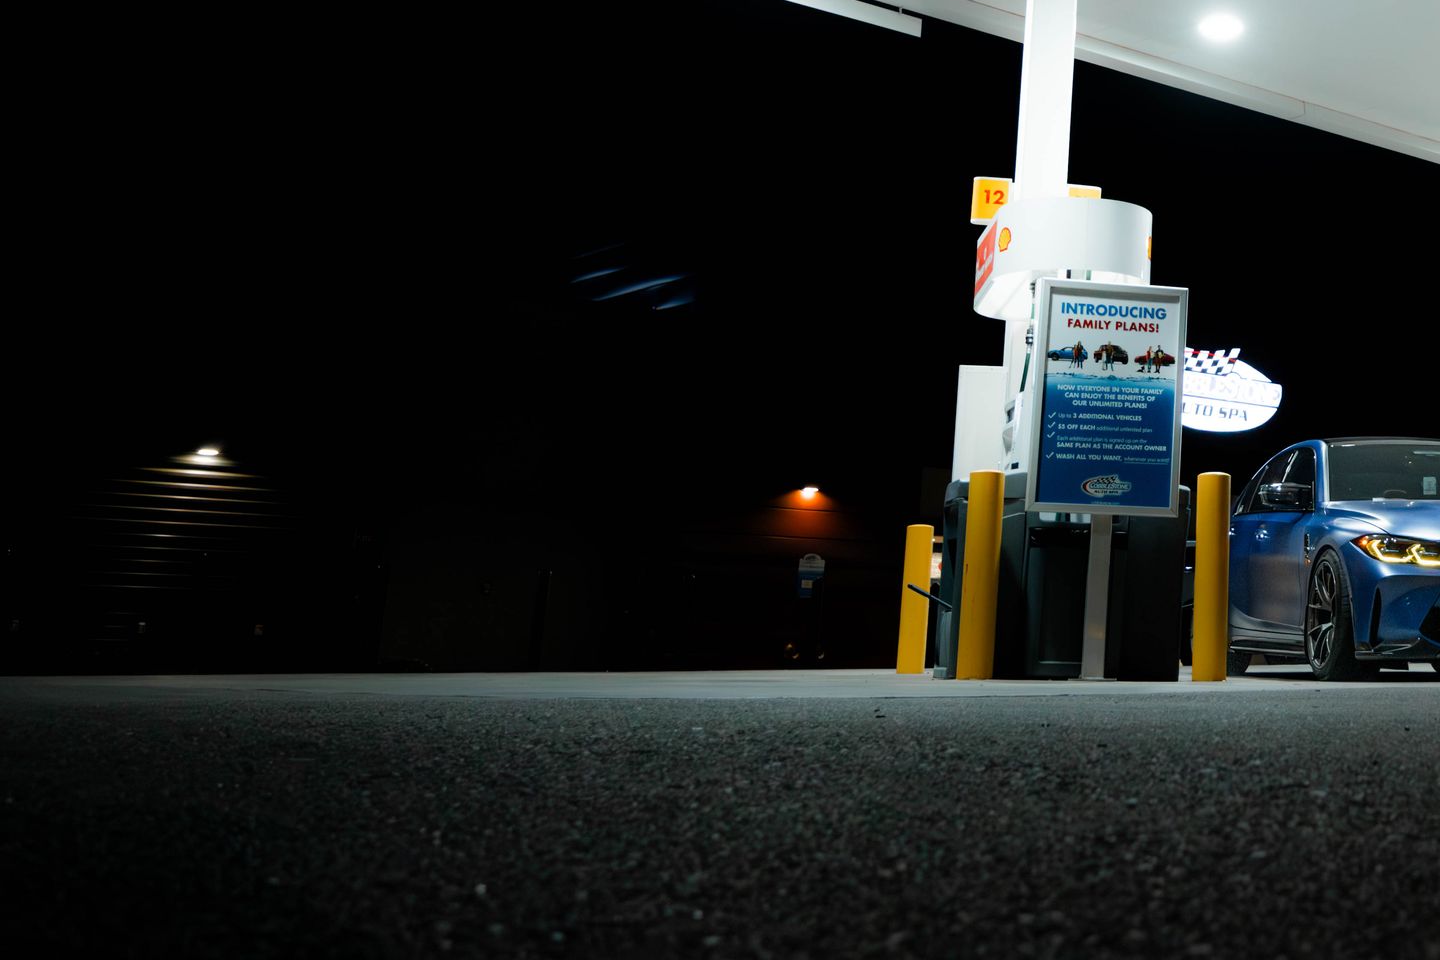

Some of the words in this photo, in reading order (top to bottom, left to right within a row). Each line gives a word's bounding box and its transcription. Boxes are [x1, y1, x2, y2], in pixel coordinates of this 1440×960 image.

[984, 190, 1005, 204] 12
[1061, 302, 1167, 319] INTRODUCING
[1068, 319, 1111, 330] FAMILY
[1116, 321, 1159, 333] PLANS!
[1219, 407, 1248, 421] SPA
